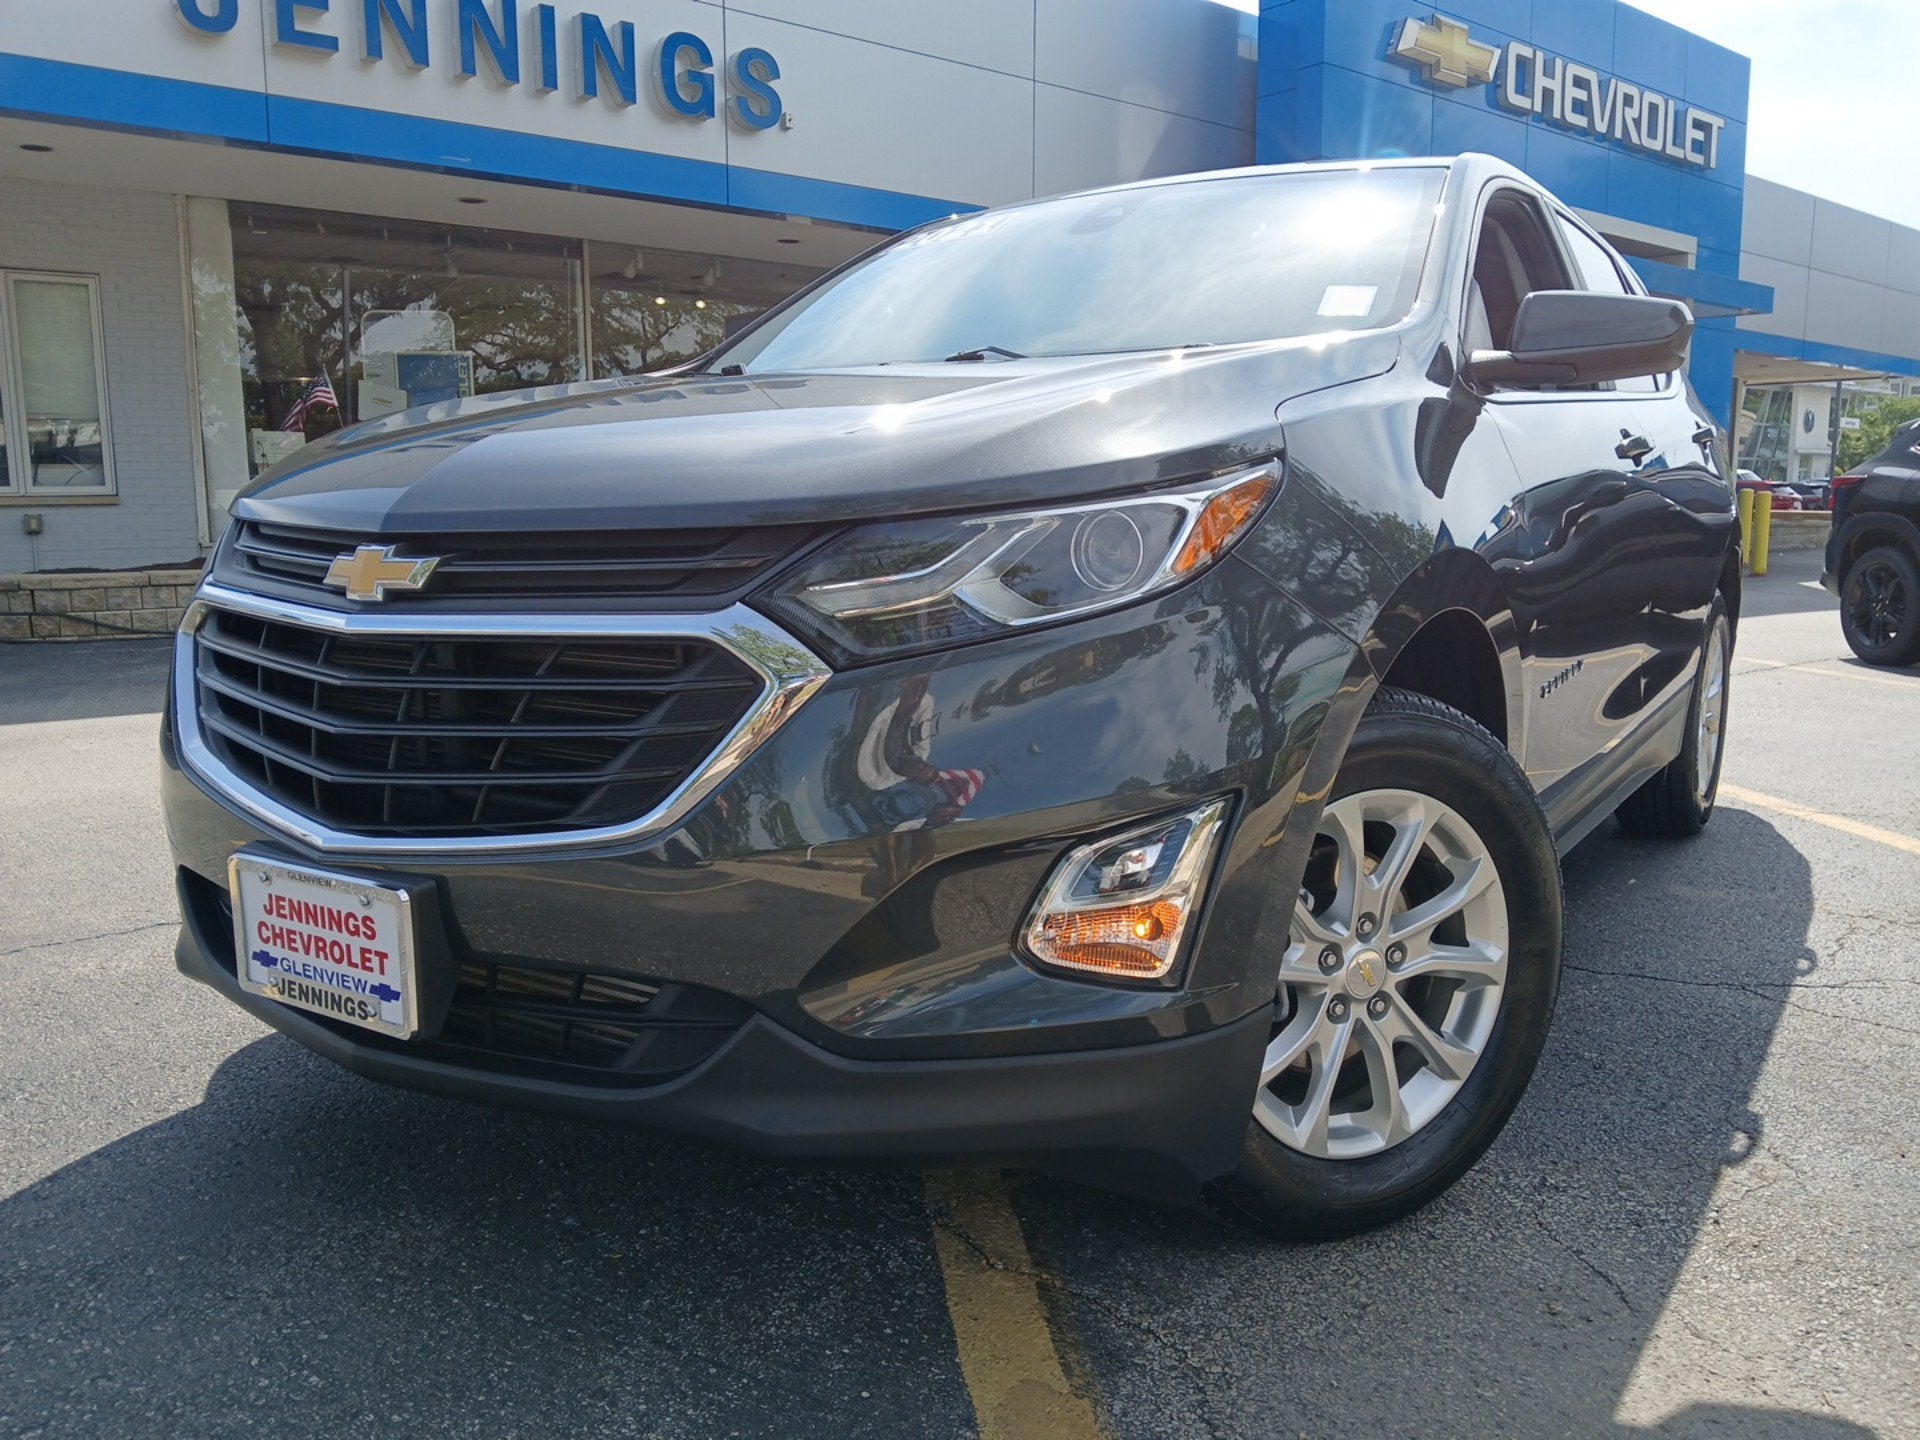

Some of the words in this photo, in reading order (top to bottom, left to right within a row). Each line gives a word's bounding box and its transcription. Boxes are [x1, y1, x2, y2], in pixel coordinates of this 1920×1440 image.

[1505, 40, 1725, 169] CHEVROLET
[263, 893, 377, 941] JENNINGS
[257, 921, 388, 976] CHEVROLET
[276, 978, 369, 1021] JENNINGS
[279, 957, 368, 994] GLENVIEW
